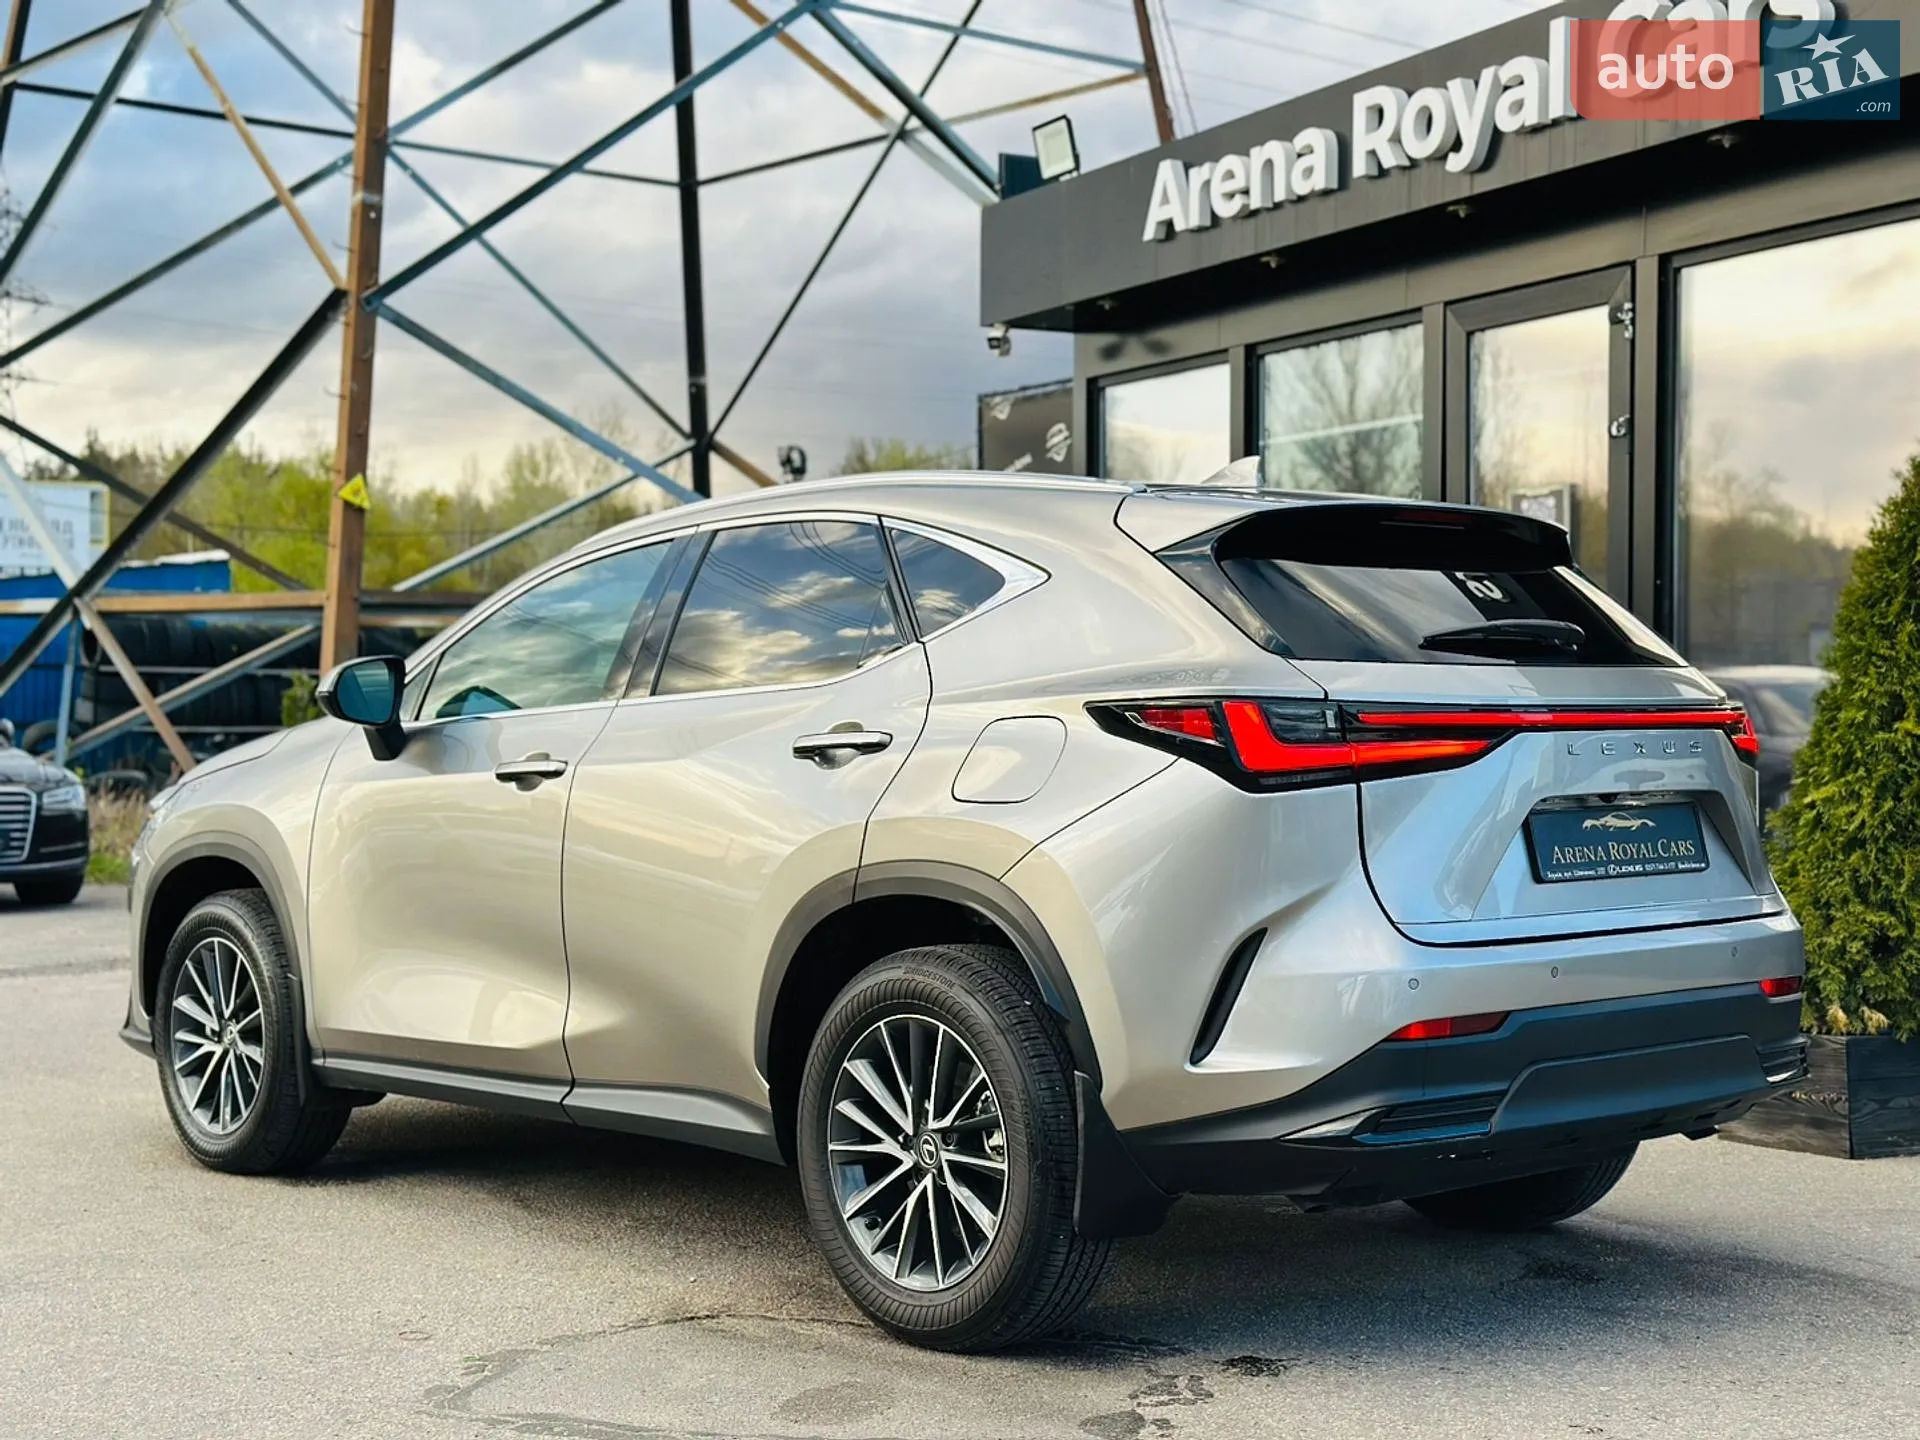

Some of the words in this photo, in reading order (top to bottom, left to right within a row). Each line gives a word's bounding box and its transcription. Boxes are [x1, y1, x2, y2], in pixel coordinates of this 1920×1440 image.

[1142, 127, 1339, 242] Arena
[1353, 16, 1577, 178] Royal
[1566, 739, 1703, 756] LEXUS
[1552, 845, 1607, 864] ARENA
[1607, 841, 1658, 861] ROYAL
[1657, 838, 1696, 858] CARS
